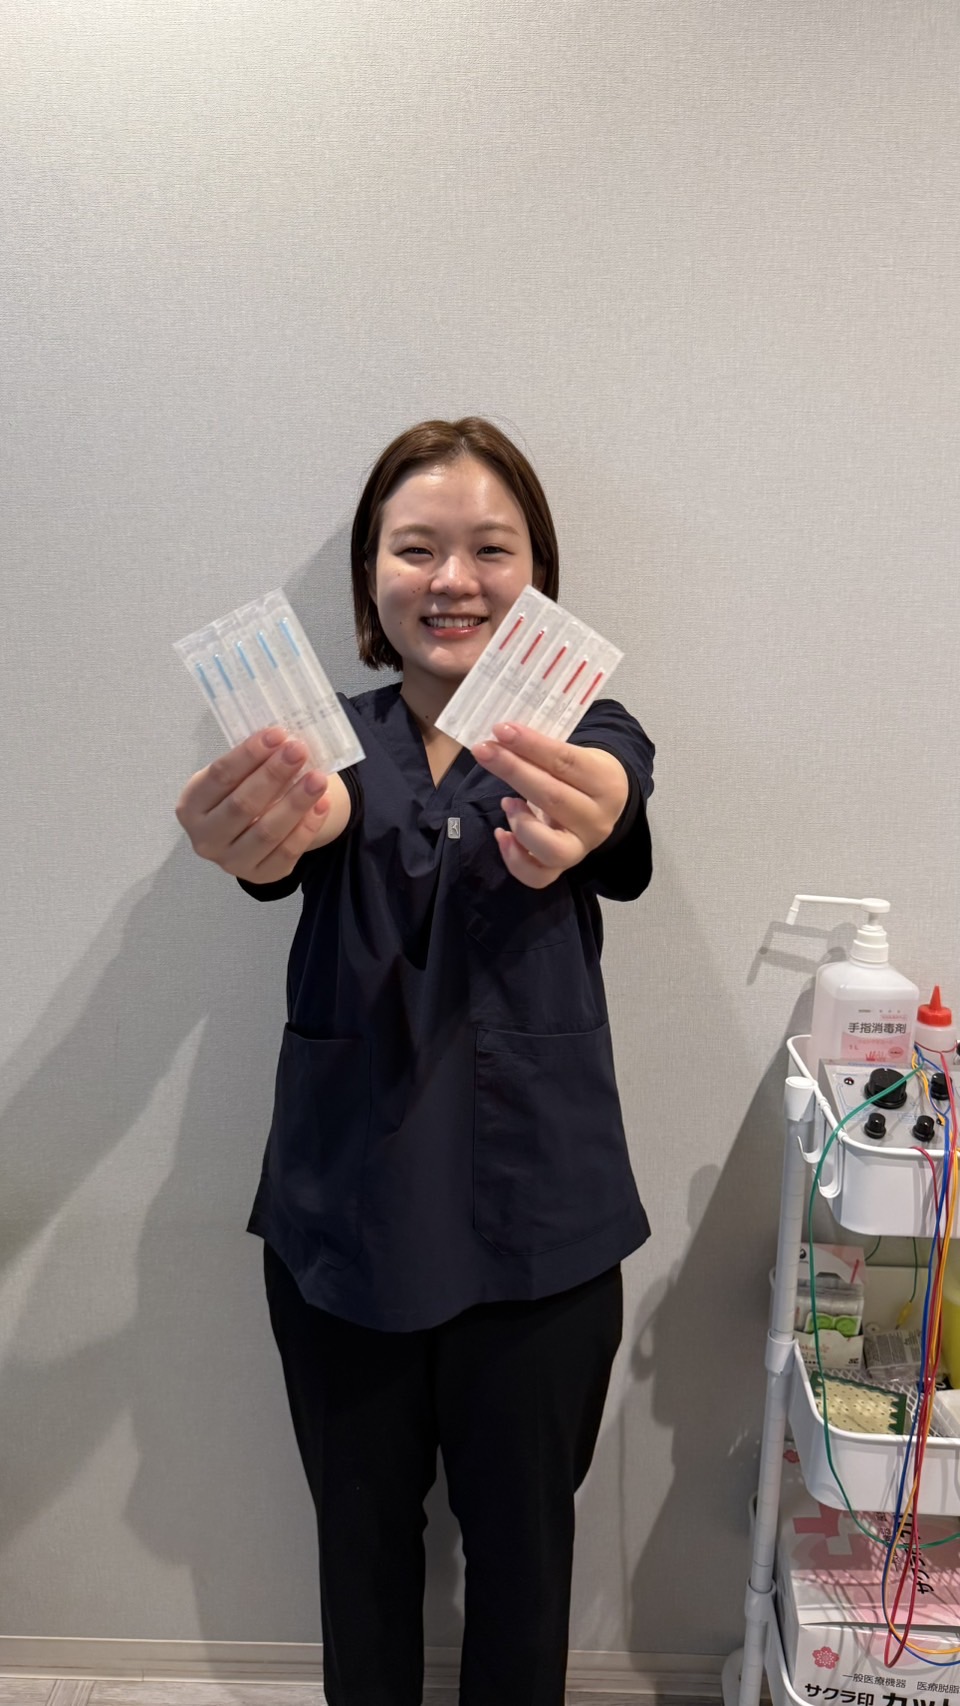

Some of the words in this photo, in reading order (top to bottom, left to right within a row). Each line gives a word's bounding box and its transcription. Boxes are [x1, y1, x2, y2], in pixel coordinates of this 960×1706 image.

[848, 1022, 907, 1034] 手指消毒剤
[842, 1673, 907, 1688] 一般医療機器
[804, 1683, 875, 1706] サクラ印
